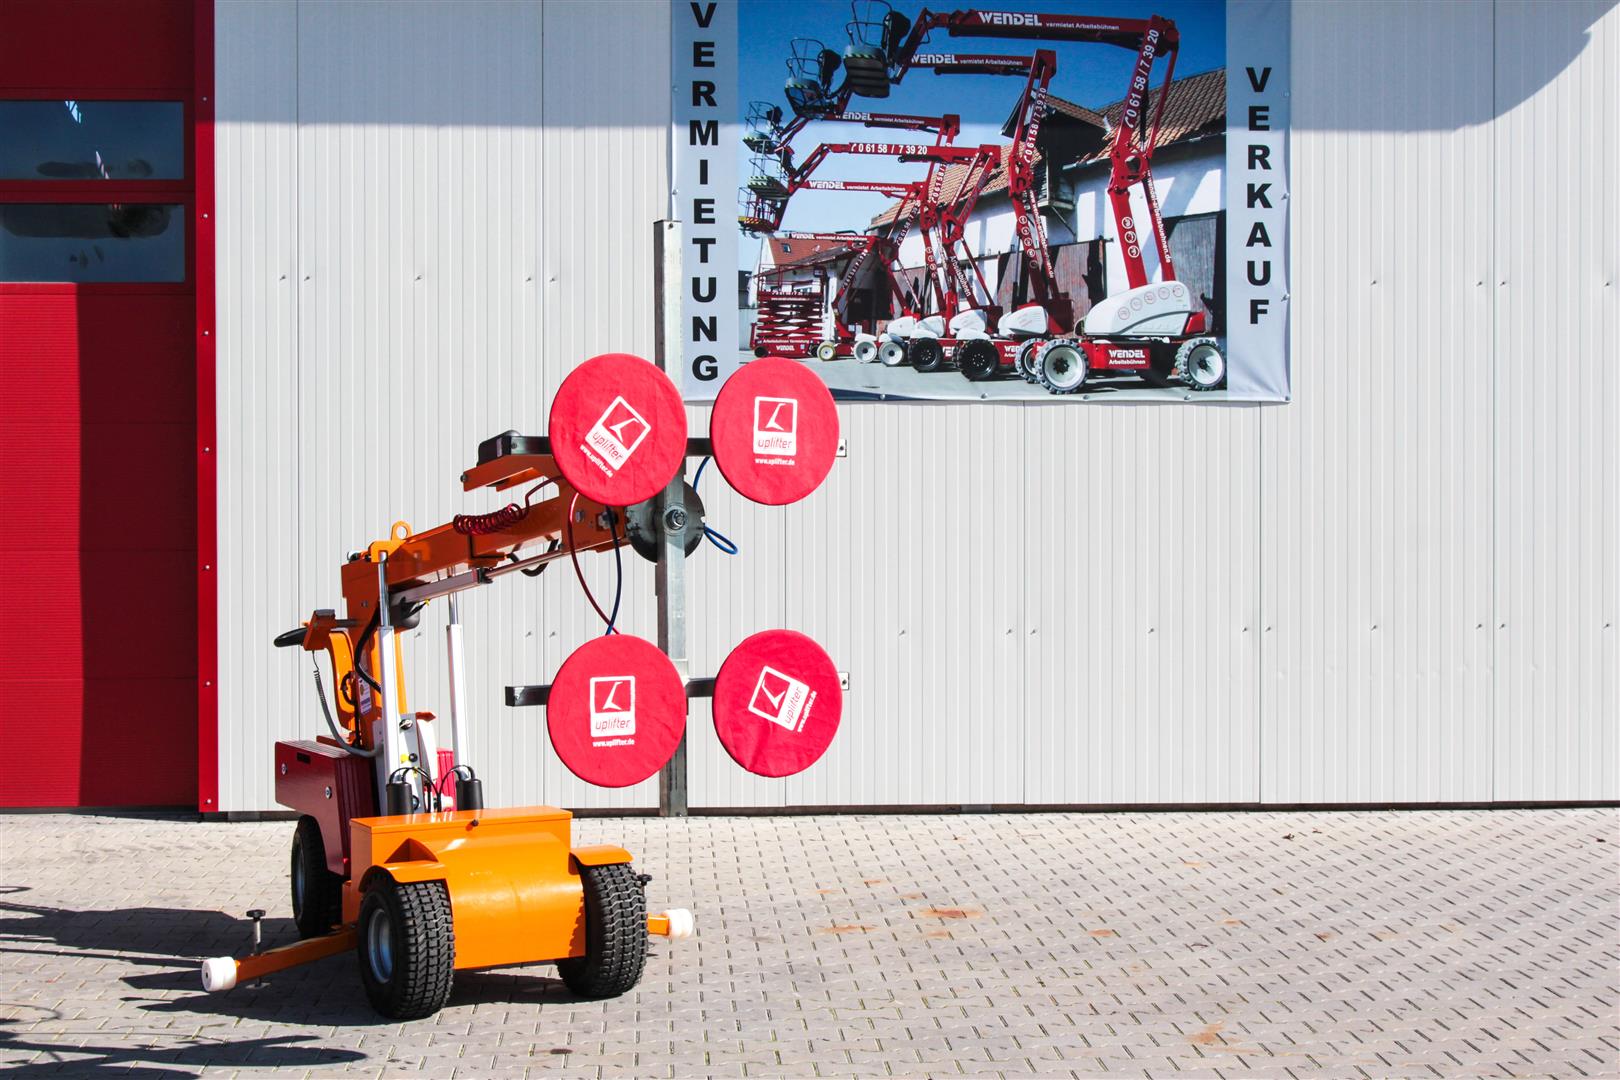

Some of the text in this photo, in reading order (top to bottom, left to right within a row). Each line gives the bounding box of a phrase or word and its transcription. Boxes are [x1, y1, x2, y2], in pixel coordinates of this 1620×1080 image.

[978, 11, 1042, 26] WENDEL
[835, 111, 872, 121] ENDEL
[689, 2, 719, 382] VERMIETUNG
[1245, 67, 1272, 325] VERKAUF
[1108, 349, 1145, 358] WENDEL
[592, 431, 623, 461] uplifter
[757, 437, 793, 450] uplifter
[785, 687, 803, 724] uplifter
[595, 717, 631, 732] uplifter
